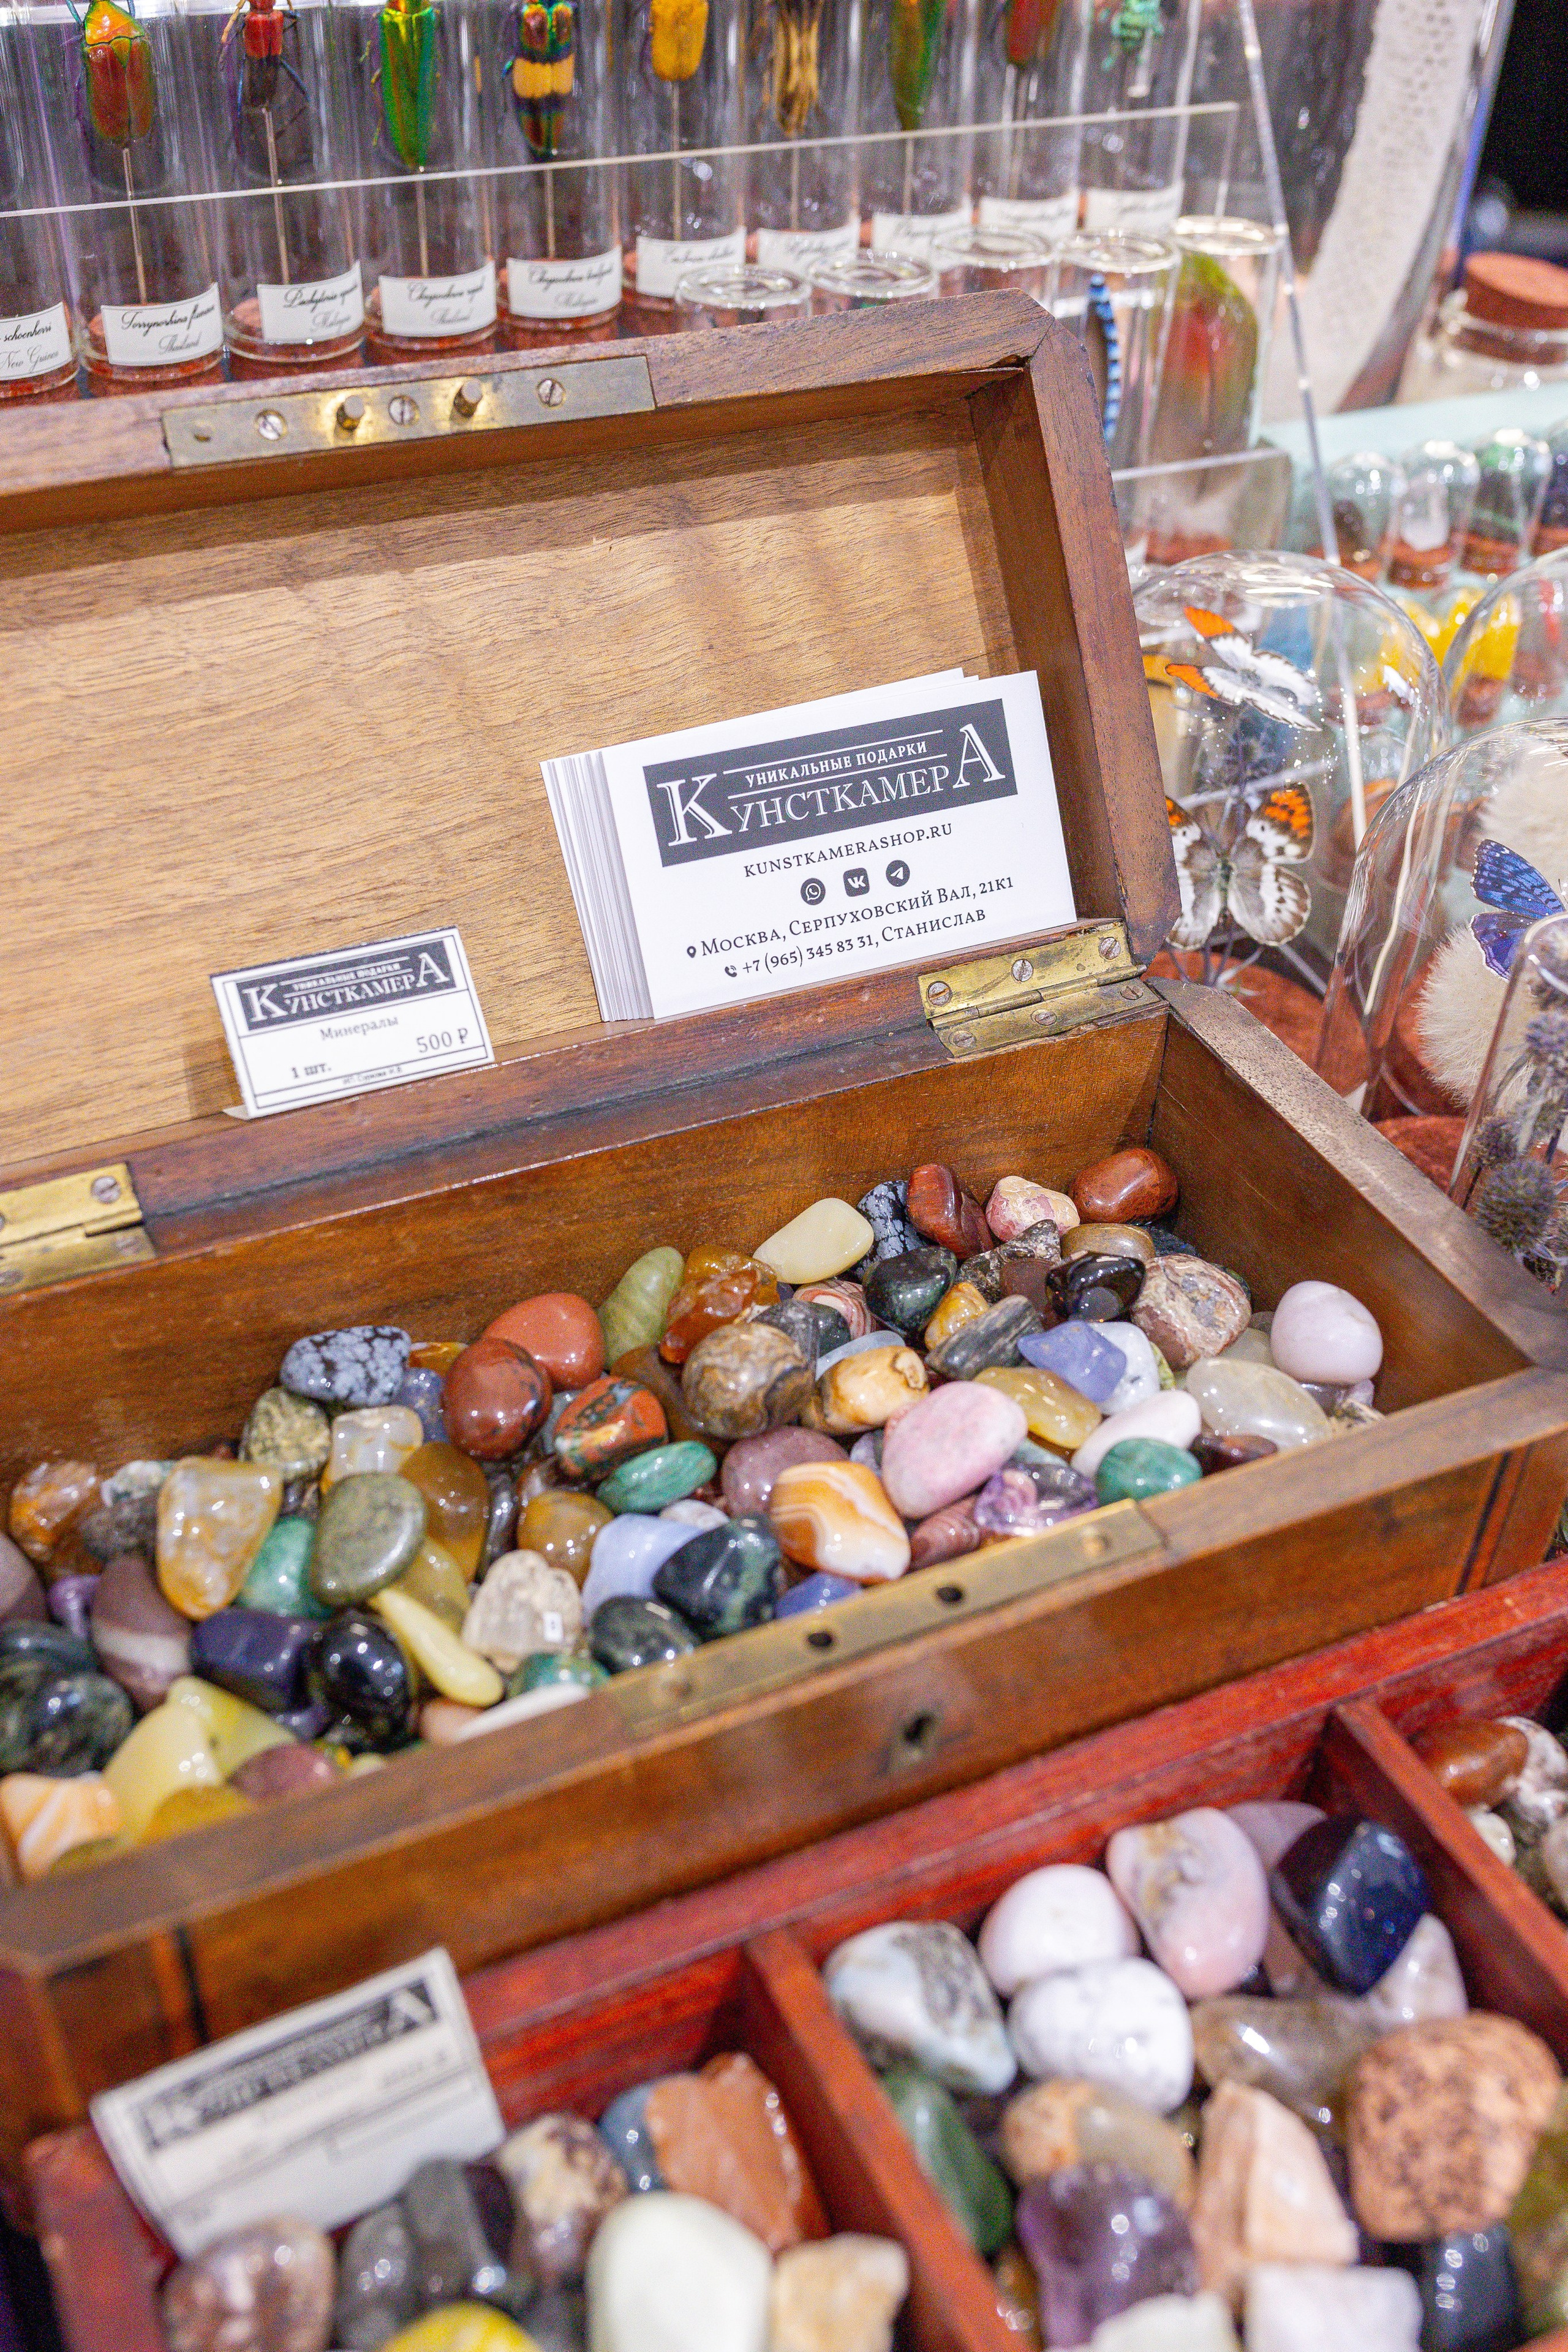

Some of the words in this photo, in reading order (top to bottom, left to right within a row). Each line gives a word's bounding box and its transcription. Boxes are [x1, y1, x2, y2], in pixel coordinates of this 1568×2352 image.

[745, 757, 852, 788] УНИКАЛЬНЫЕ
[856, 741, 927, 765] ПОДАРКИ
[657, 723, 1006, 847] КУНСТКАМЕРА
[744, 823, 952, 877] KUNSTKAMERASHOP.RU
[742, 960, 760, 974] +7
[764, 946, 804, 974] (965)
[807, 943, 833, 960] 345
[837, 939, 854, 953] 83
[858, 934, 879, 949] 31,
[320, 1016, 399, 1040] Минералы
[416, 1031, 452, 1053] 500
[291, 1066, 300, 1079] 1
[304, 1063, 331, 1076] шт.
